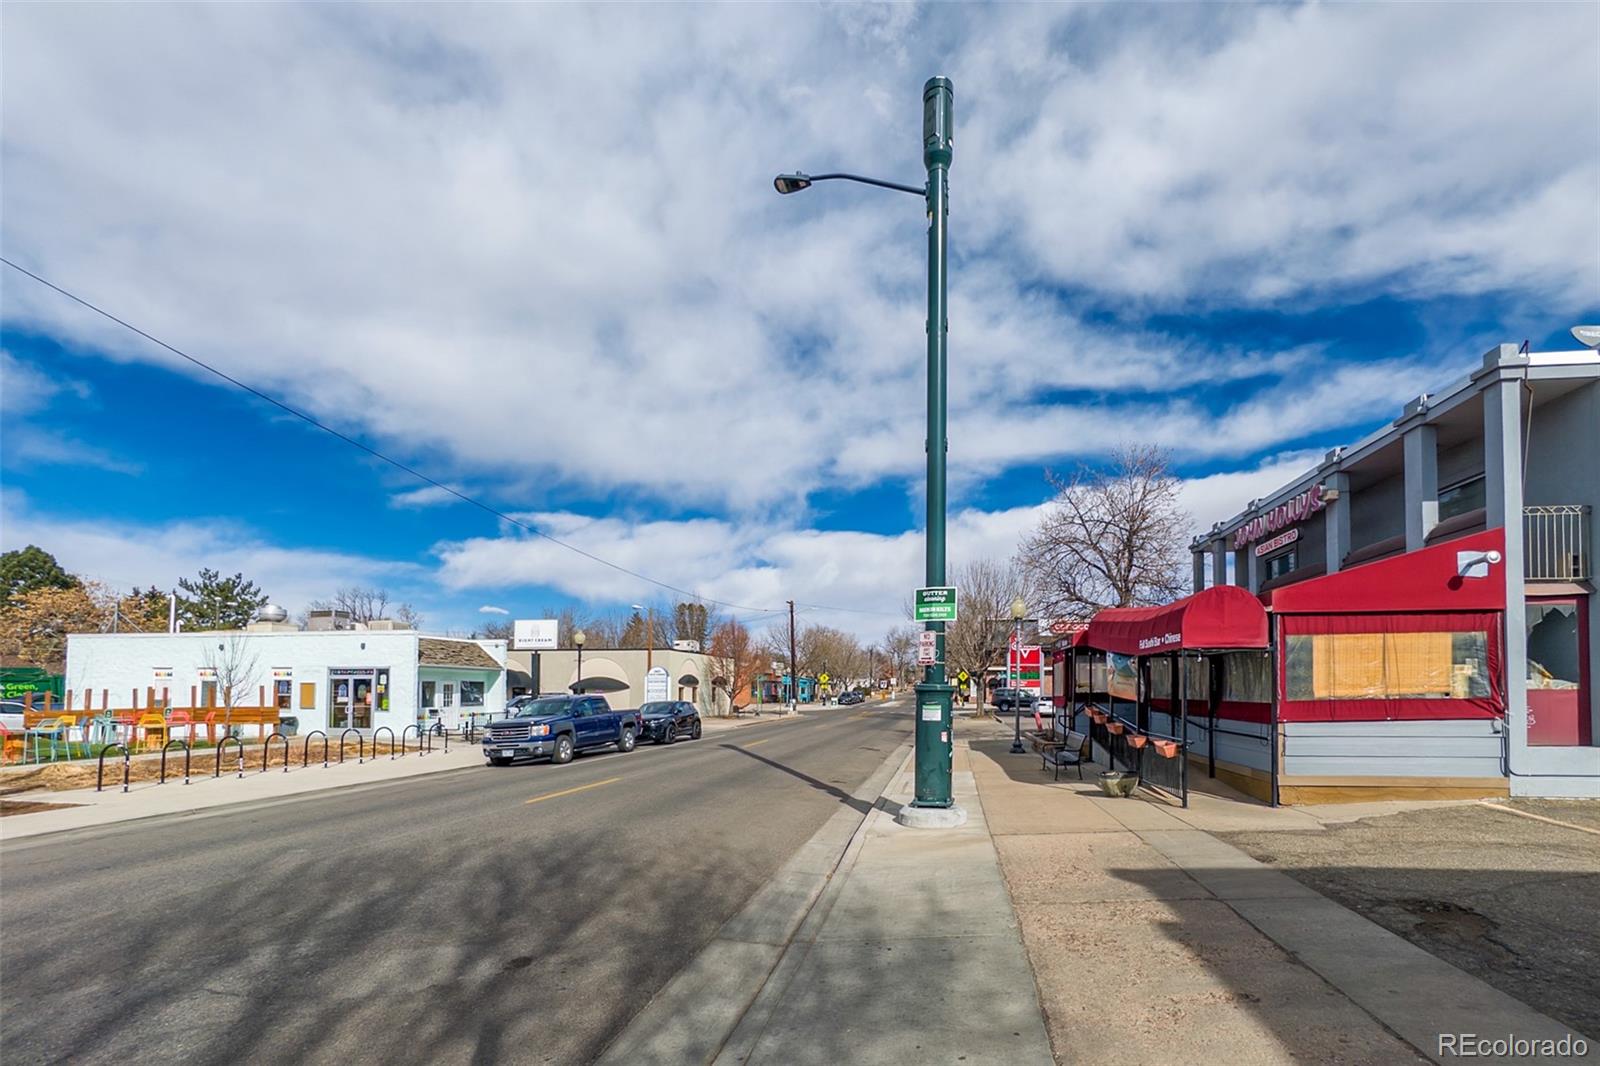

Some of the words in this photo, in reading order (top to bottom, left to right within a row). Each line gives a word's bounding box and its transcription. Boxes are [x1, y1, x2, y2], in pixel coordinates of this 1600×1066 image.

[1234, 517, 1266, 550] JOHN
[1257, 541, 1273, 555] ASIAN
[1274, 530, 1297, 548] BISTRO
[1164, 632, 1181, 644] Chinese
[6, 683, 38, 691] Green,
